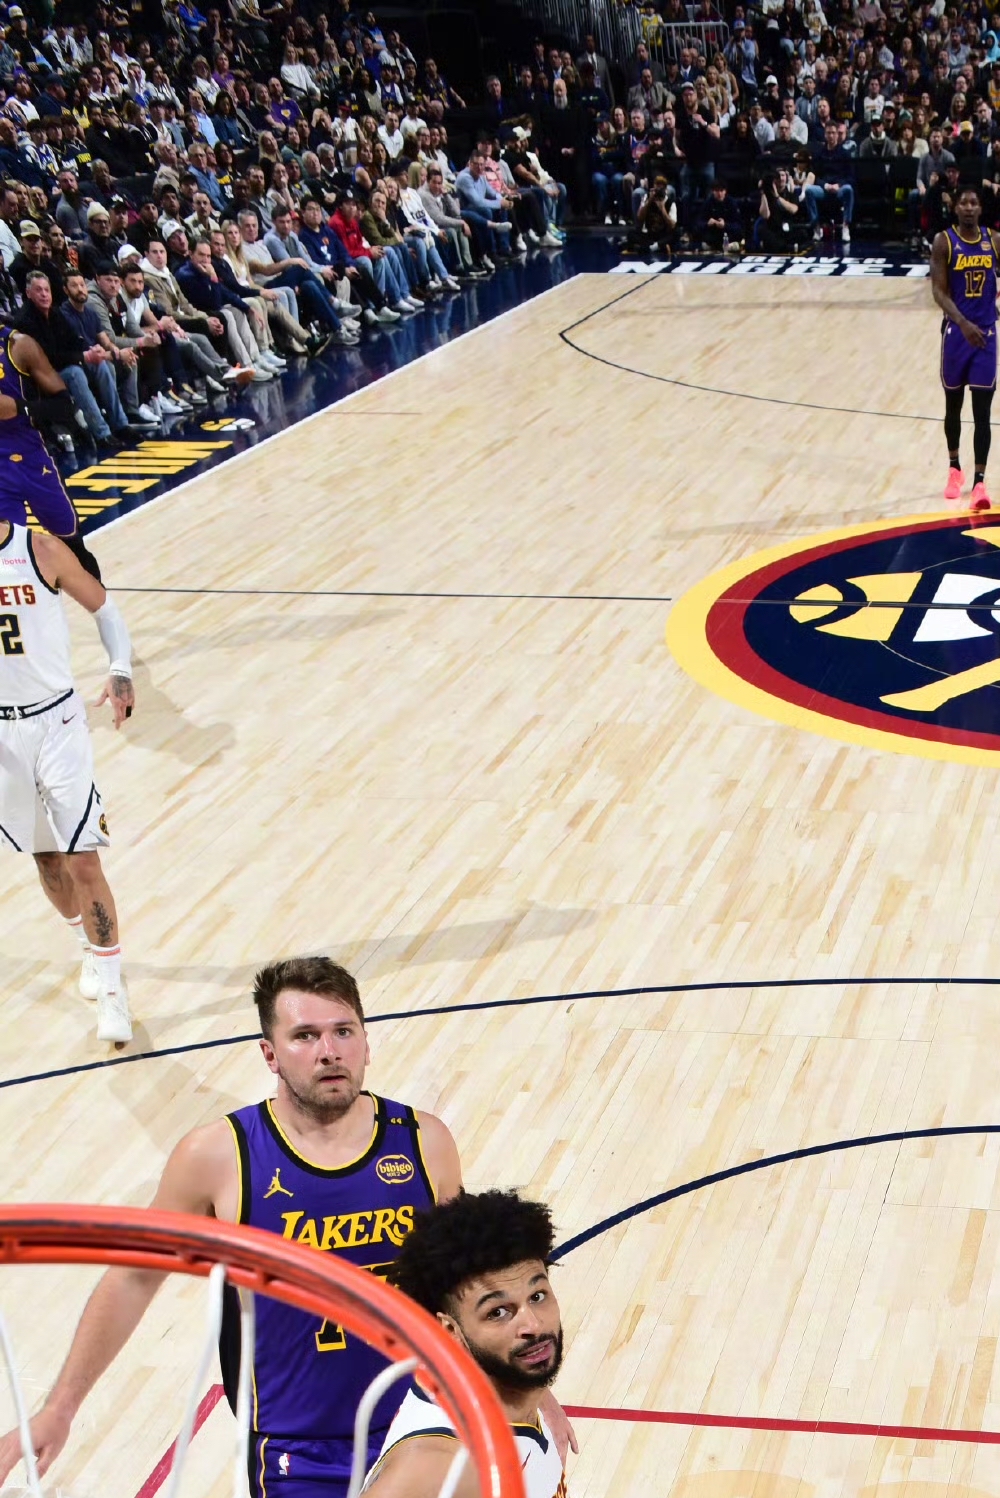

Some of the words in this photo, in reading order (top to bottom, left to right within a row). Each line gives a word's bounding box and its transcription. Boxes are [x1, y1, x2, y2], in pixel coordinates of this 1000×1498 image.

[741, 255, 887, 264] DENVER
[953, 253, 993, 271] LAKERS
[608, 260, 931, 278] NUGGET
[965, 270, 986, 297] 17
[1, 557, 27, 566] ibotta
[0, 584, 36, 606] ETS
[0, 613, 25, 656] 2
[379, 1161, 412, 1175] bibigo
[280, 1205, 415, 1251] LAKERS
